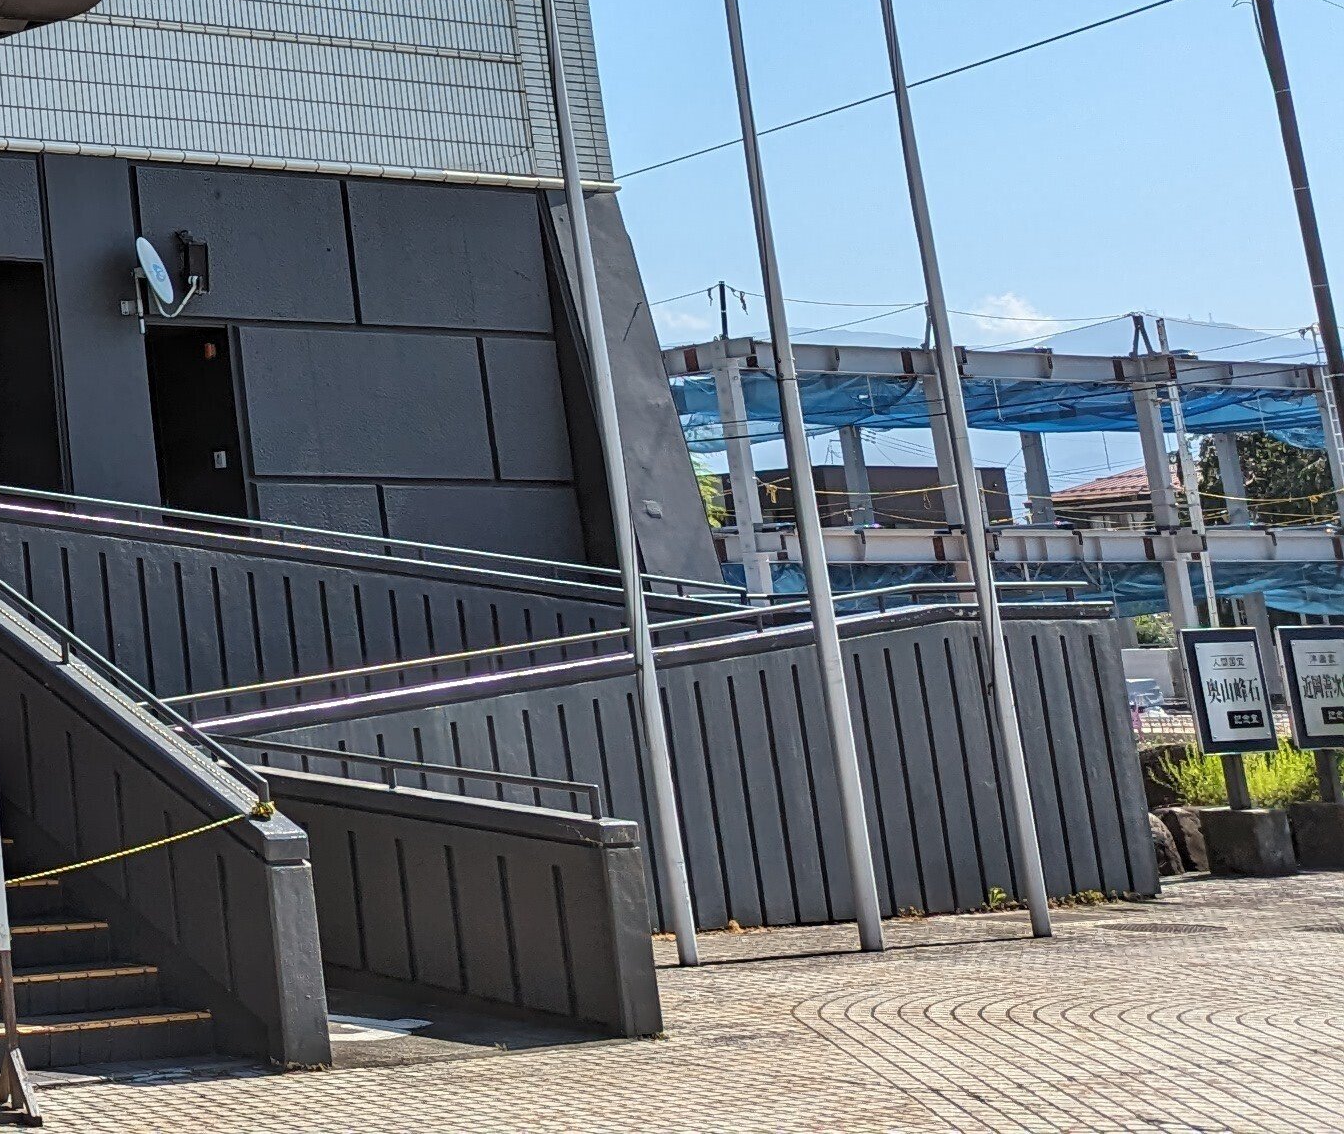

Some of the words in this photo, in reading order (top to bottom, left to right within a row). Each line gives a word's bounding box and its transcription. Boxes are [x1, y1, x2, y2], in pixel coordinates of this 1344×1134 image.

[1206, 677, 1261, 704] 奥山峰石
[1300, 673, 1344, 700] 近岡善次
